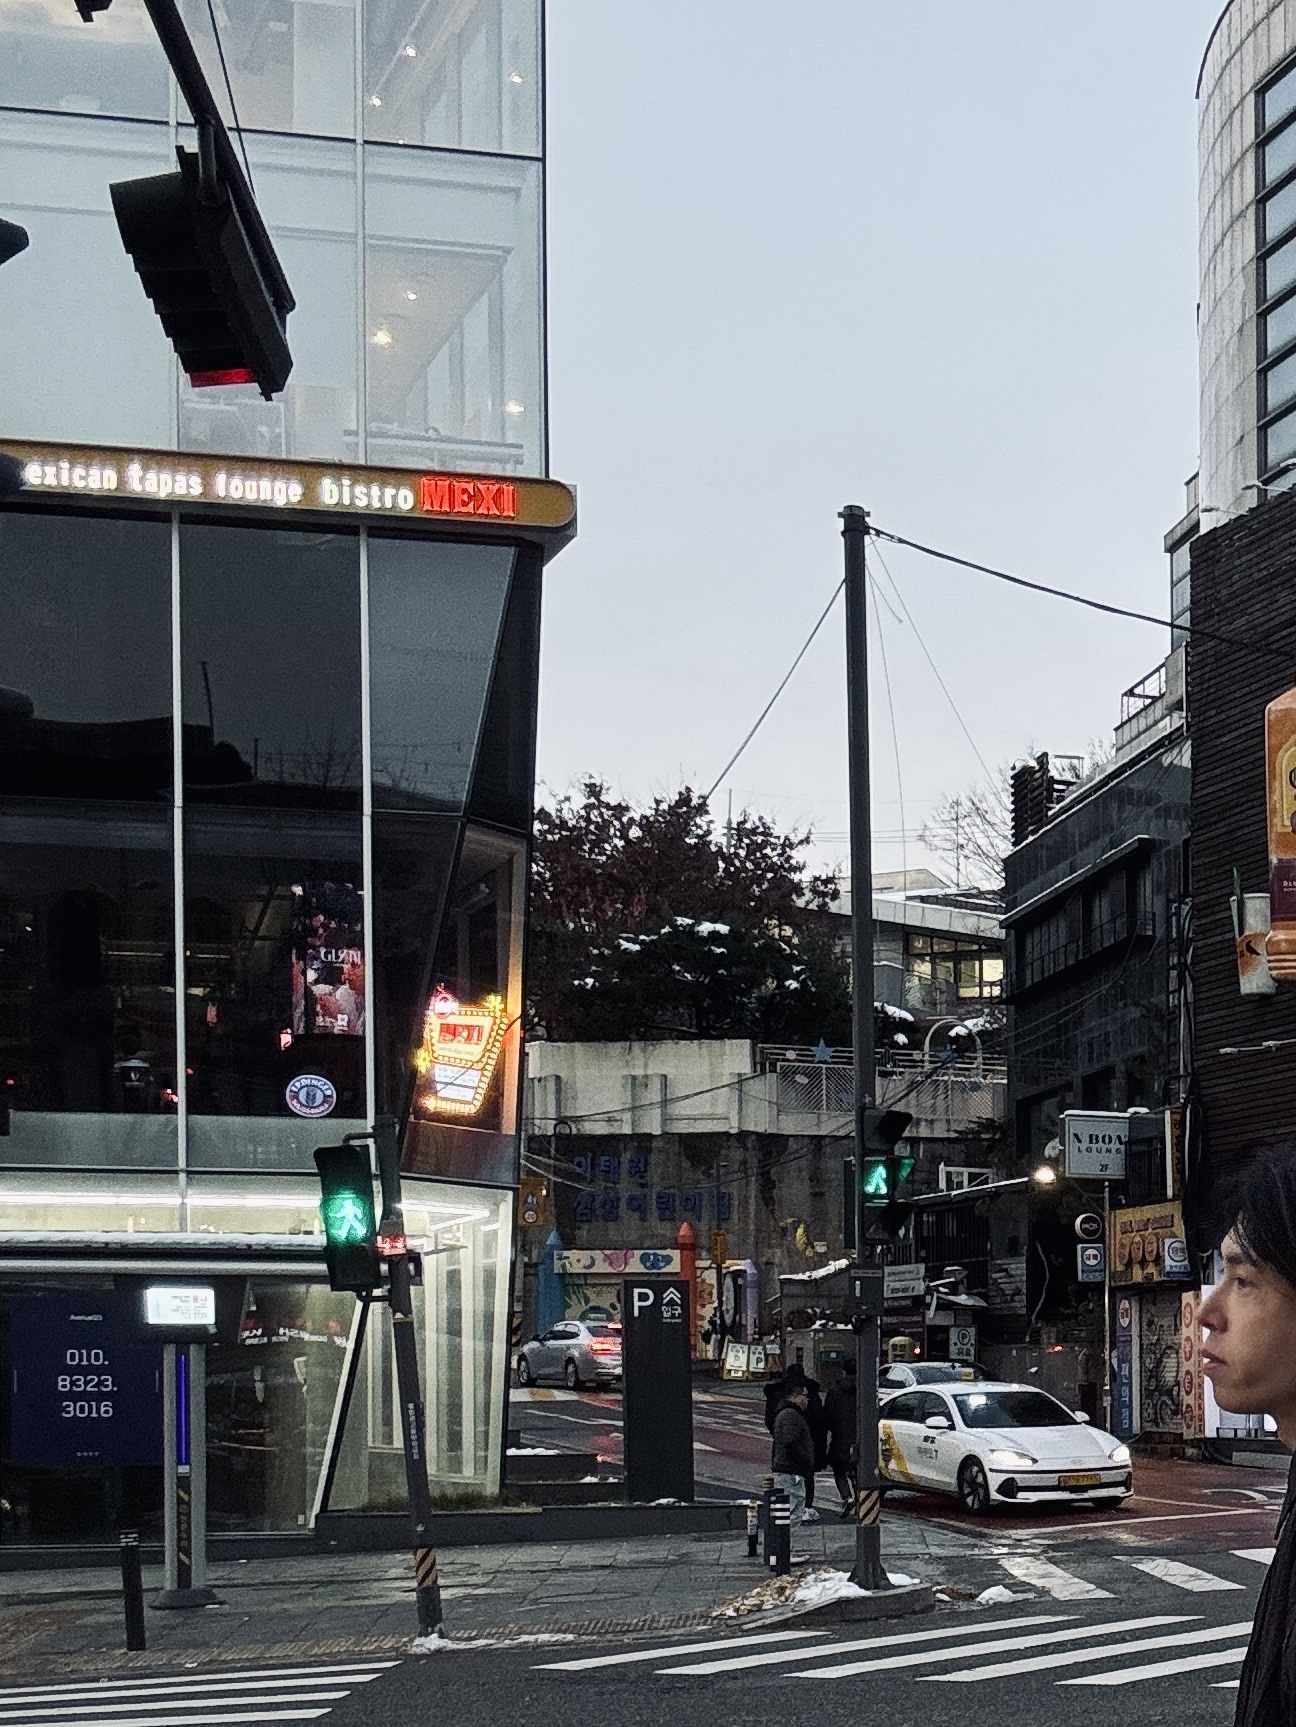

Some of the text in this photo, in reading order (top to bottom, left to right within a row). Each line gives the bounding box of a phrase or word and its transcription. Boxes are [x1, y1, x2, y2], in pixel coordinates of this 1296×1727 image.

[24, 460, 517, 518] exican tapas lounge bistro MEXI
[633, 1287, 655, 1318] P
[66, 1349, 109, 1365] 010.
[57, 1375, 118, 1391] 8323.
[61, 1401, 113, 1418] 3016
